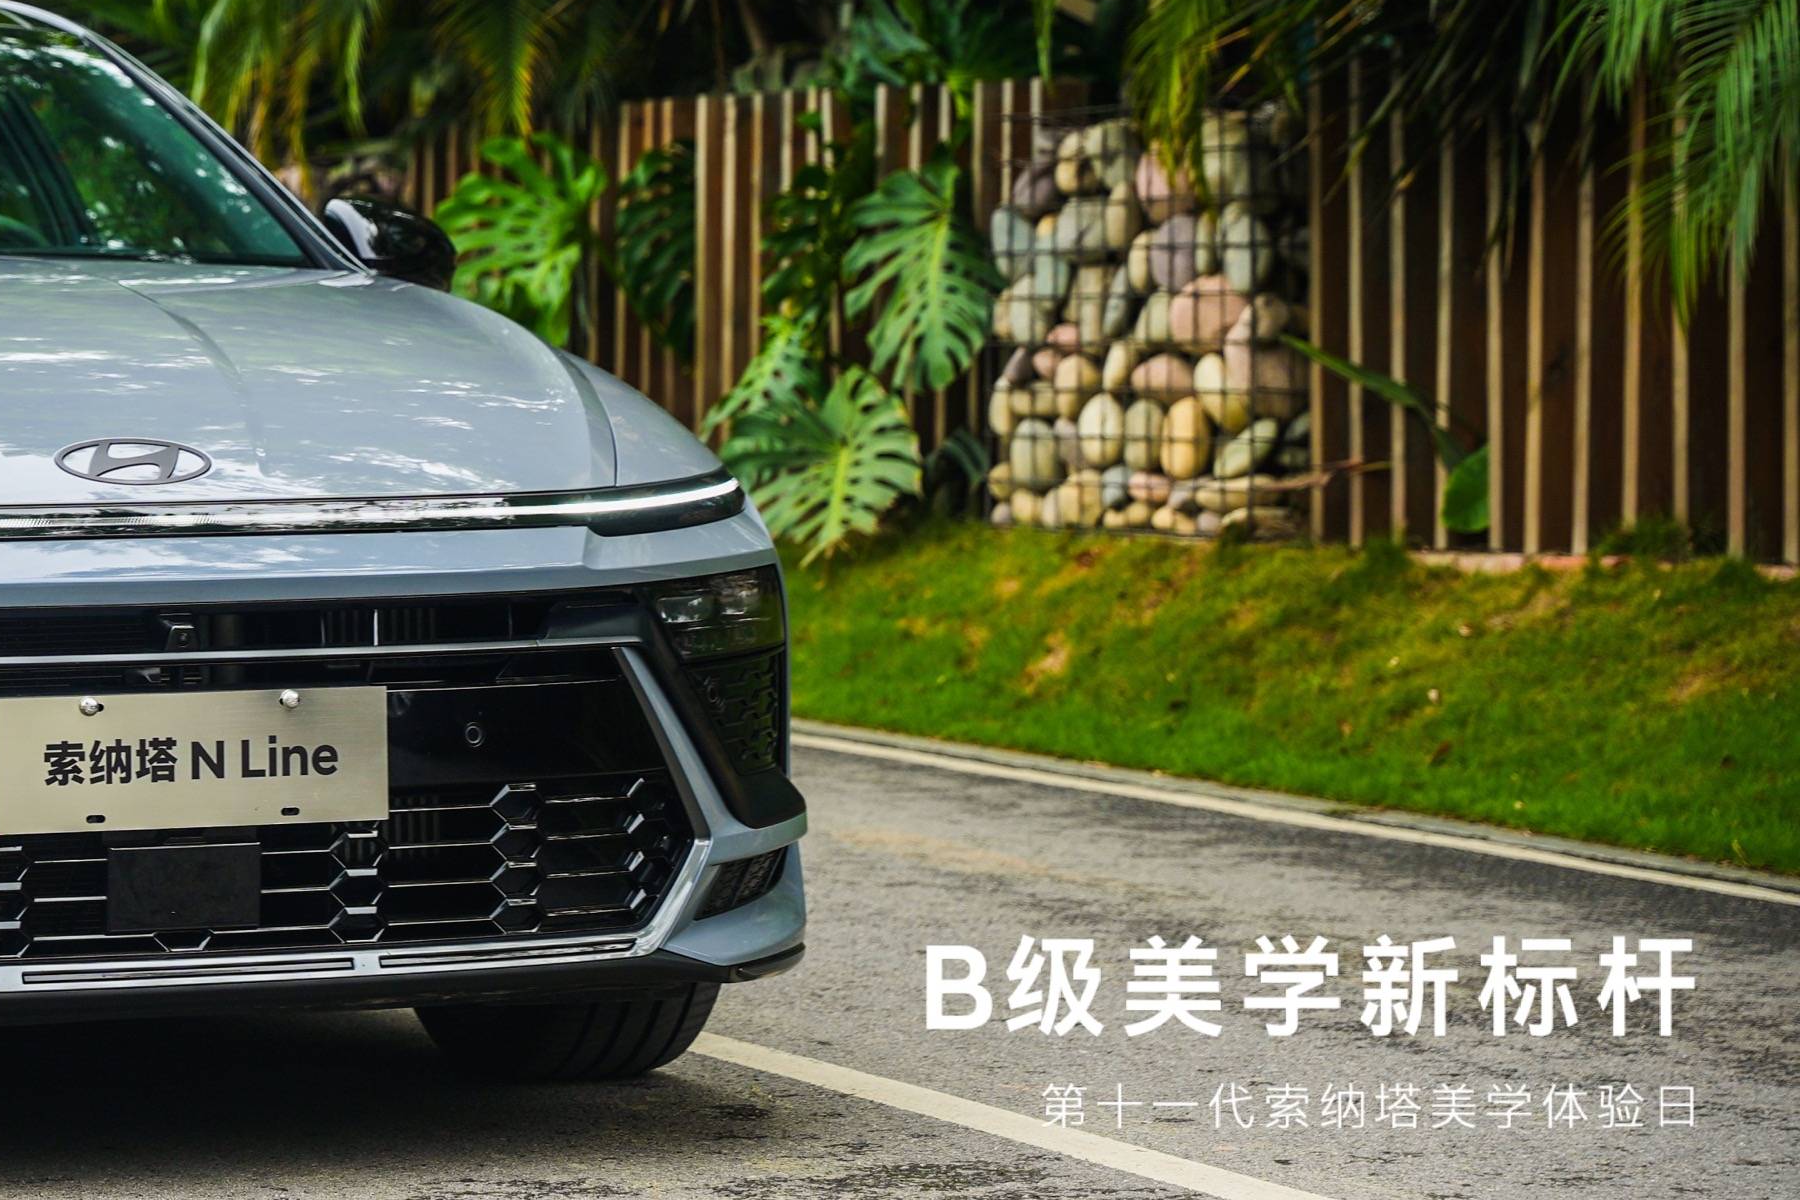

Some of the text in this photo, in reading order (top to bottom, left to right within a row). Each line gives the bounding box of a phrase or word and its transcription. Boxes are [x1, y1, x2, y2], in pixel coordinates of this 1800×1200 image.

[43, 735, 339, 786] 索纳塔 N Line
